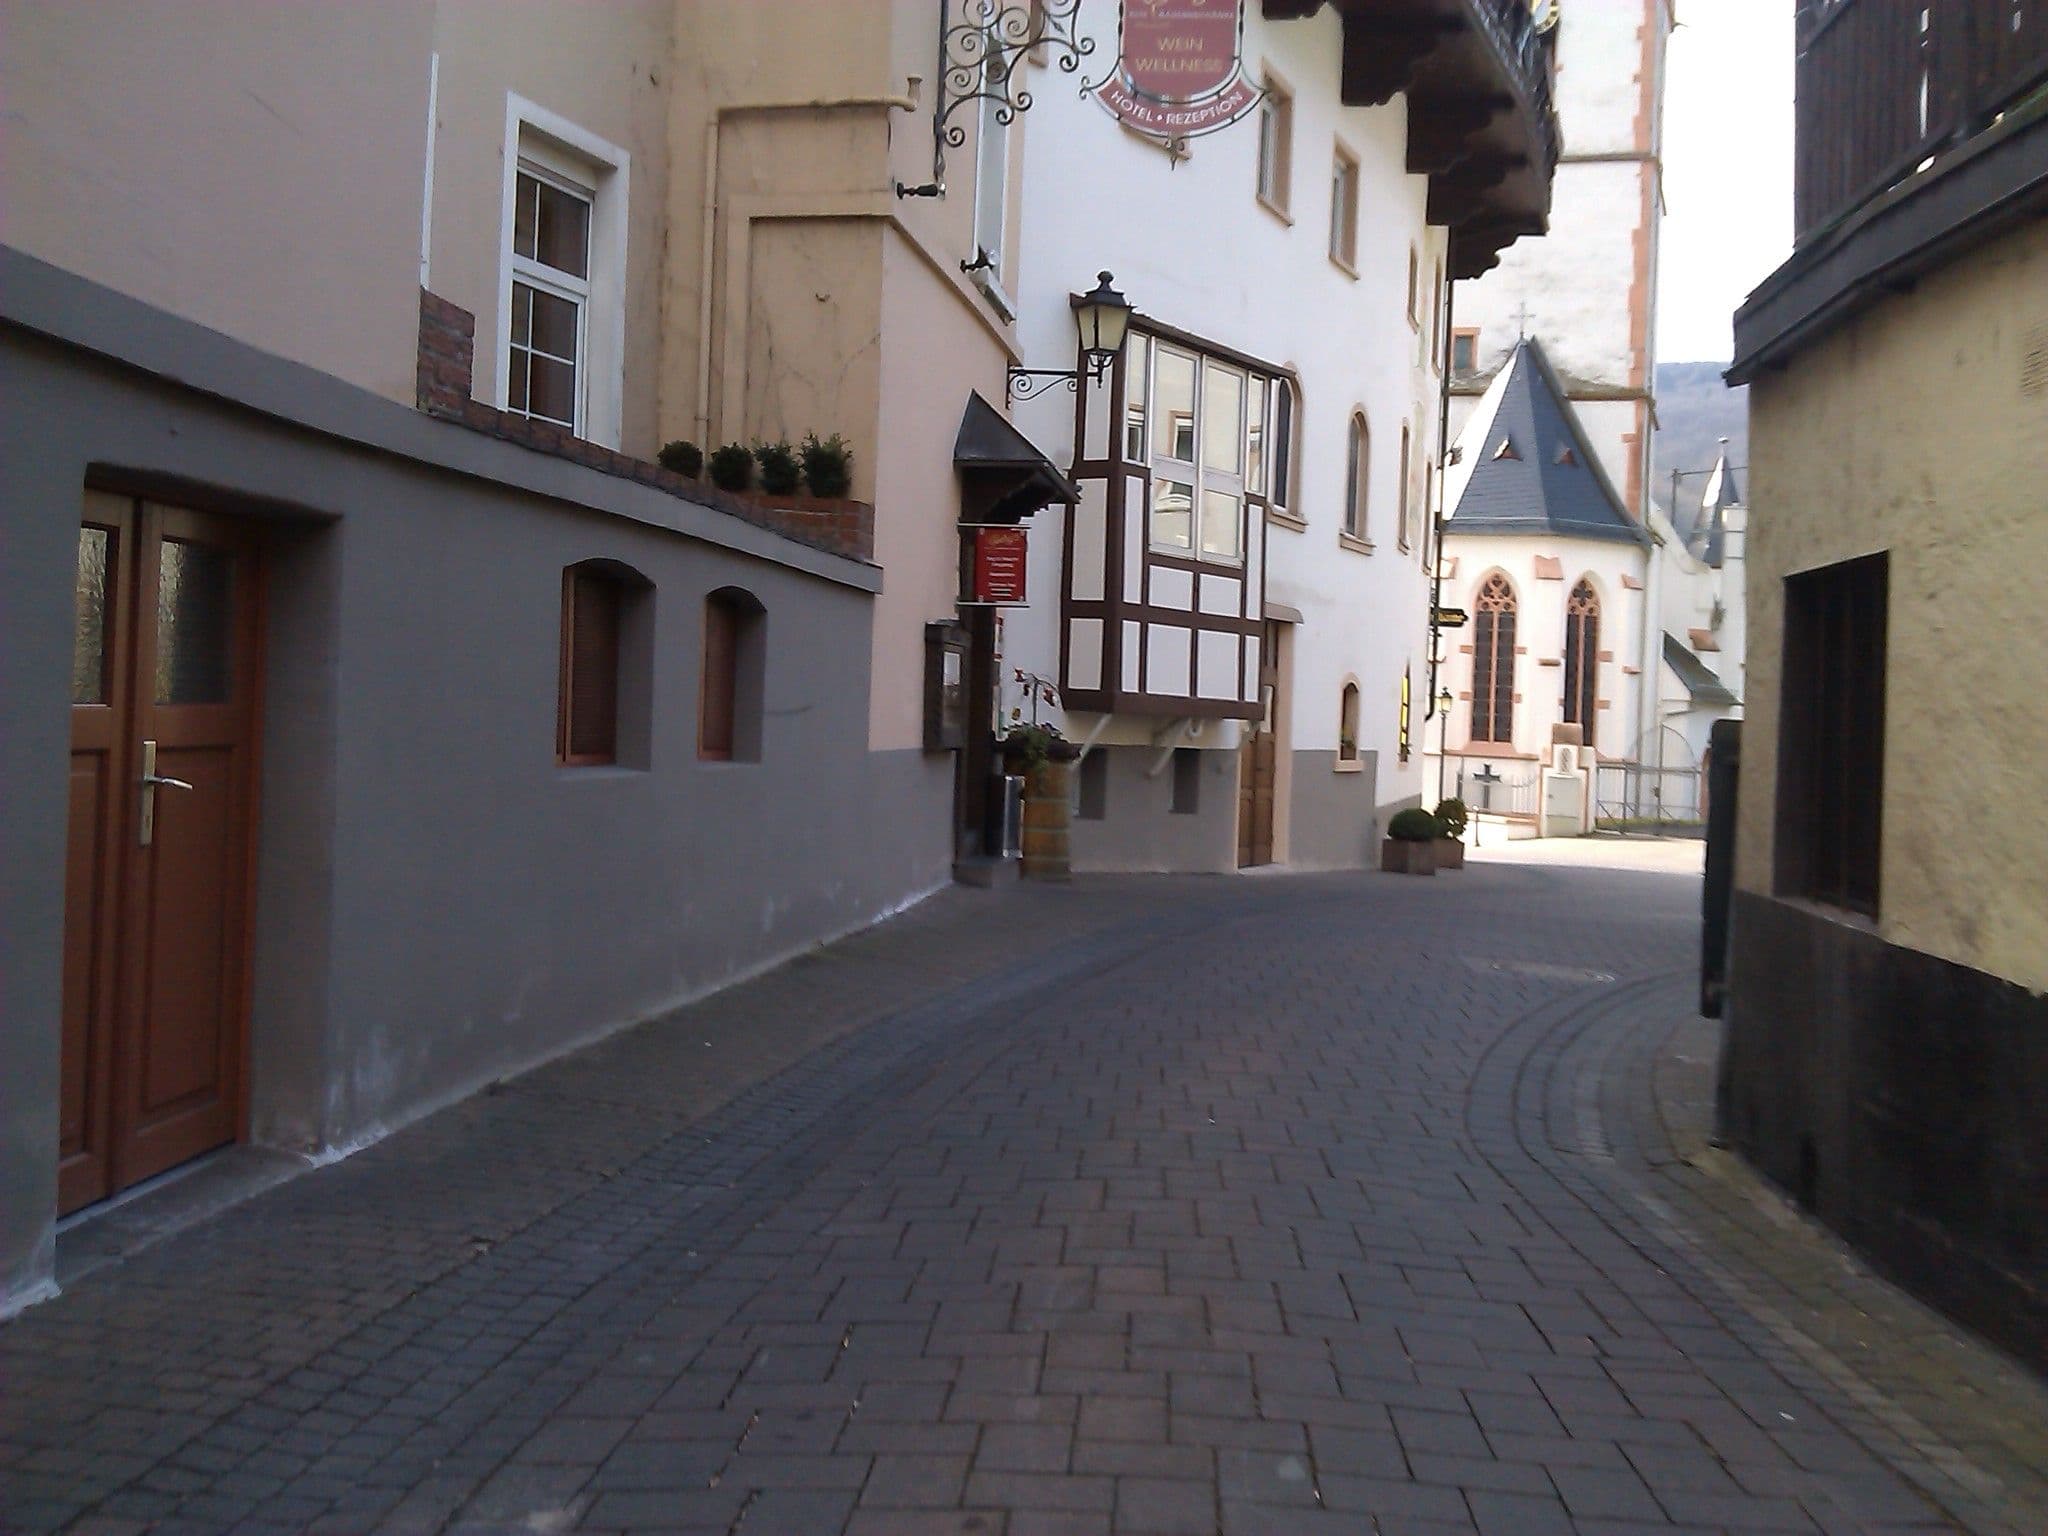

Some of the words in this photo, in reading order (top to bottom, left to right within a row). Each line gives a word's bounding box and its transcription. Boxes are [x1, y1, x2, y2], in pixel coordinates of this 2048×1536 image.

[1159, 36, 1204, 51] WEIN
[1135, 58, 1222, 73] WELLNESS
[1110, 90, 1153, 122] HOTEL
[1165, 90, 1245, 125] REZEPTION
